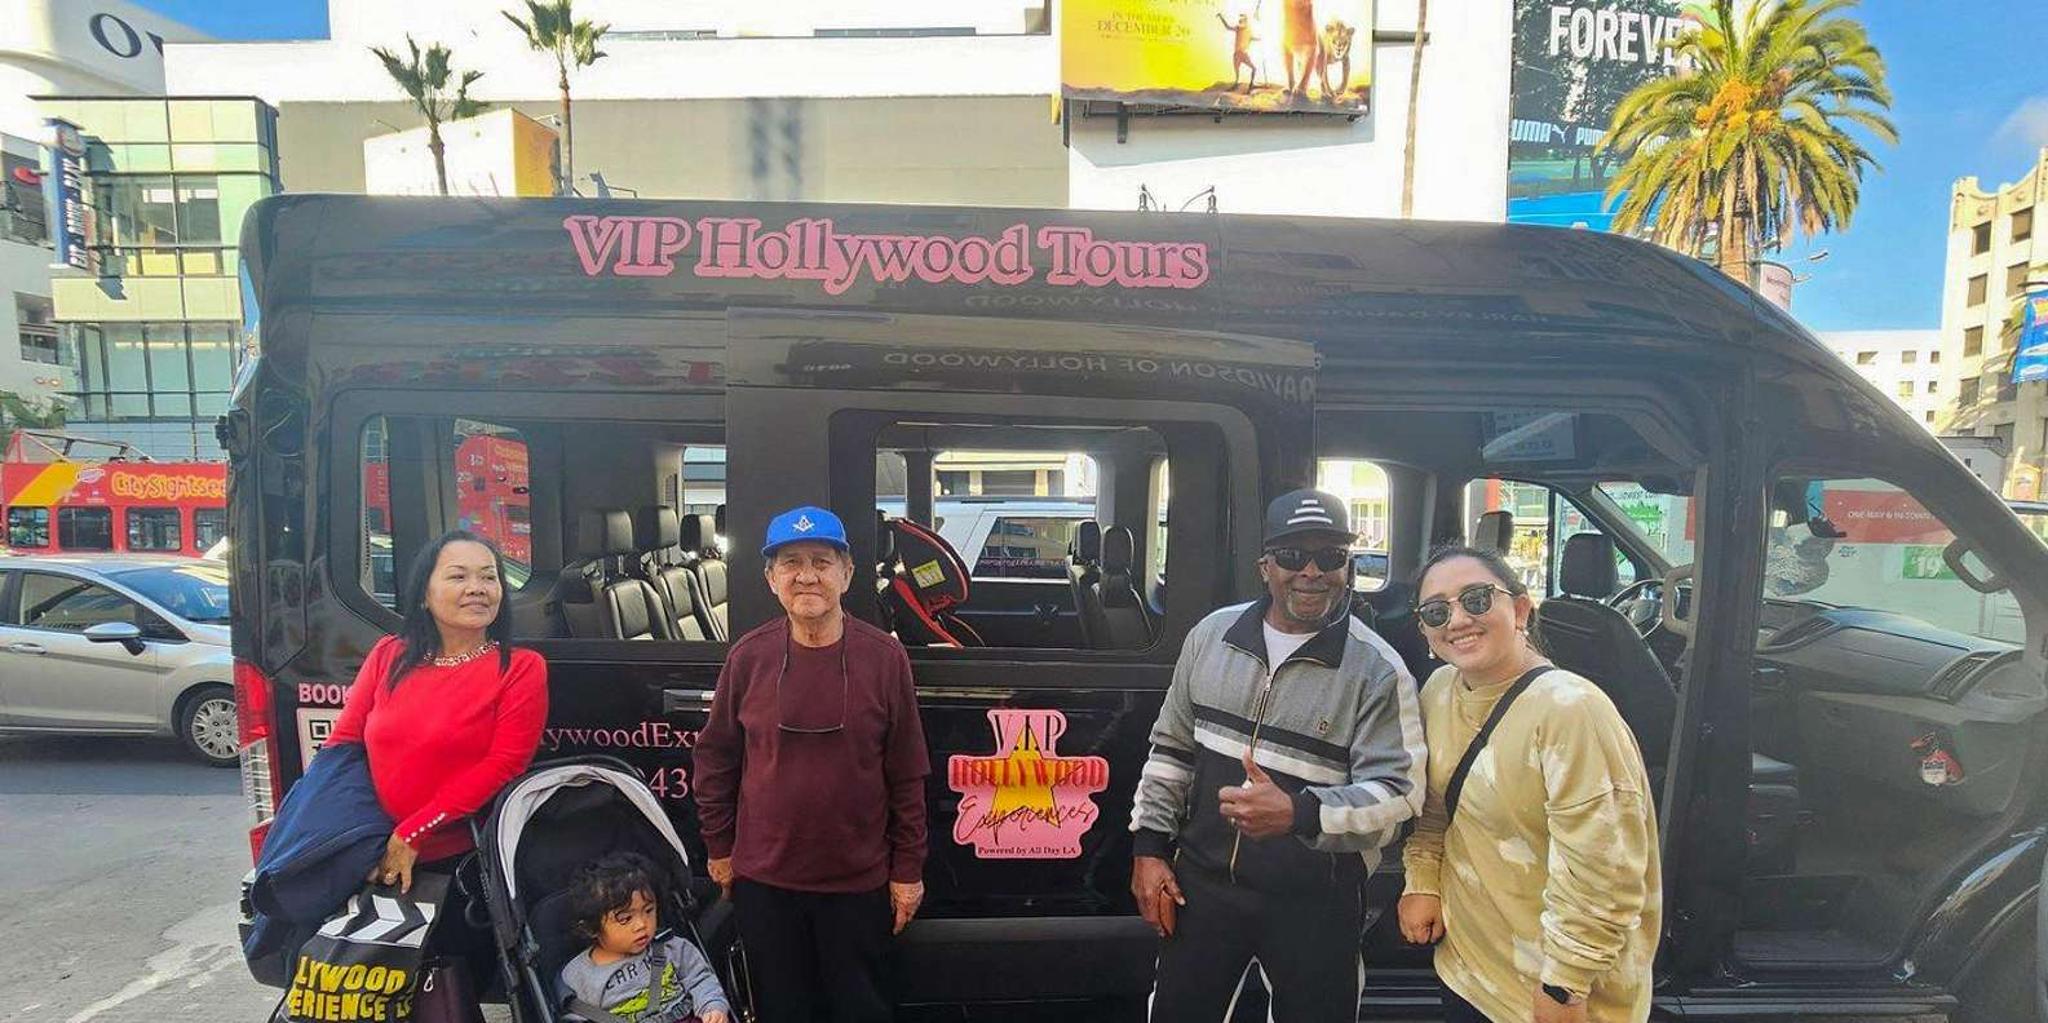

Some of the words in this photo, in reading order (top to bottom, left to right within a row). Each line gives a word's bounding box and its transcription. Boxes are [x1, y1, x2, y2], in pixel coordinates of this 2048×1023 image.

[1097, 20, 1172, 36] DECEMBER
[563, 215, 692, 276] VIP
[694, 217, 1034, 295] Hollywood
[1037, 226, 1209, 289] Tours
[637, 767, 688, 799] 43
[952, 758, 1106, 788] HOLLYWOOD
[956, 795, 1096, 846] Experiences
[978, 847, 1014, 855] Powered
[1016, 847, 1027, 856] by
[1029, 847, 1041, 855] All
[1043, 847, 1060, 856] Day
[1062, 847, 1076, 855] LA
